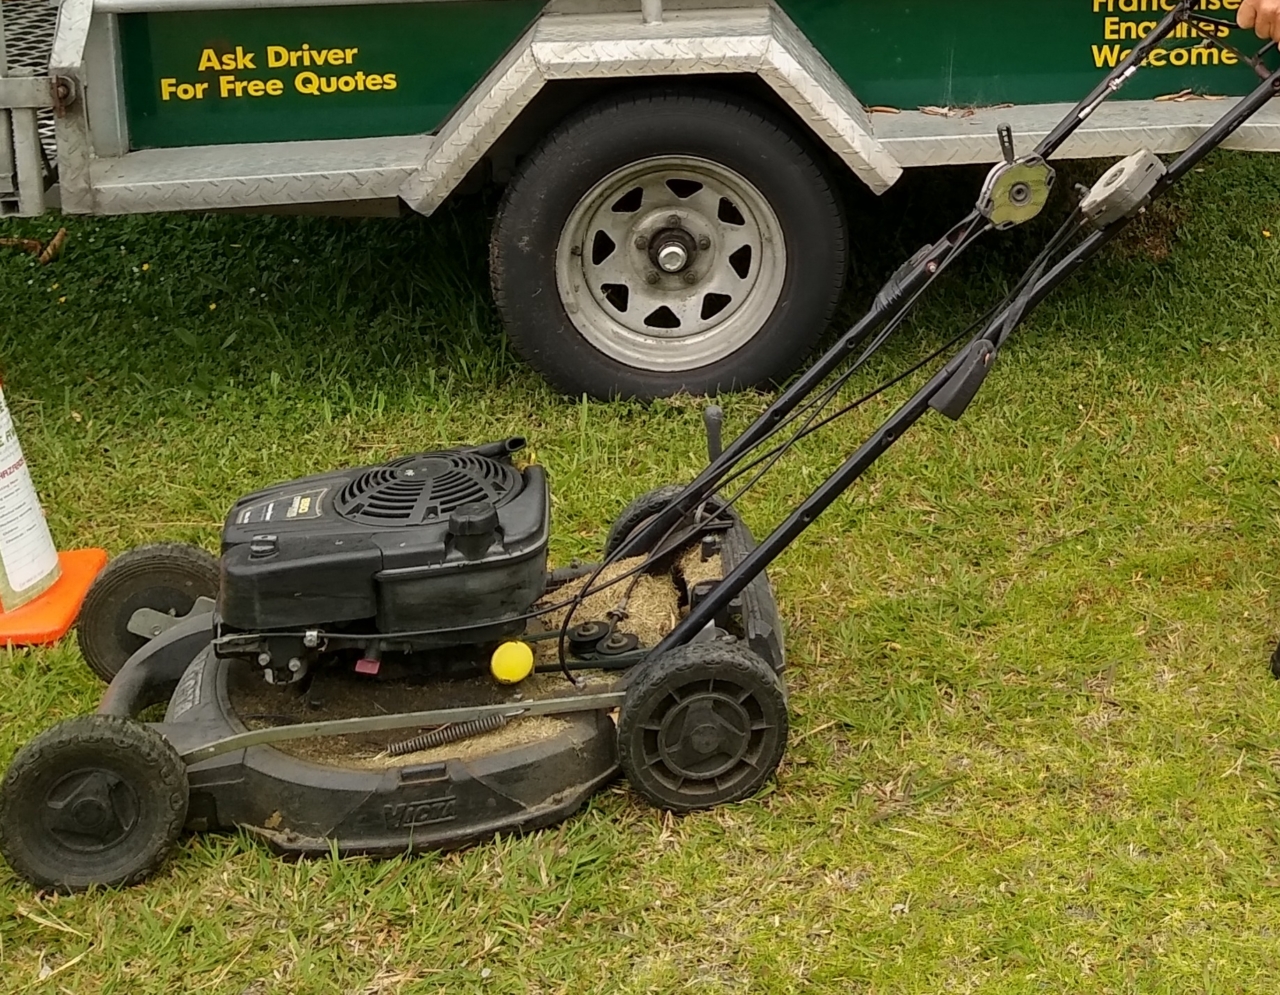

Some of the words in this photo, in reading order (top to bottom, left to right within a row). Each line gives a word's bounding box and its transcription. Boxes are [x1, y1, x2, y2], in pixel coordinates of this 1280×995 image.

[198, 47, 256, 71] Ask
[266, 44, 358, 68] Driver
[160, 78, 209, 101] For
[219, 75, 284, 98] Free
[294, 71, 397, 95] Quotes
